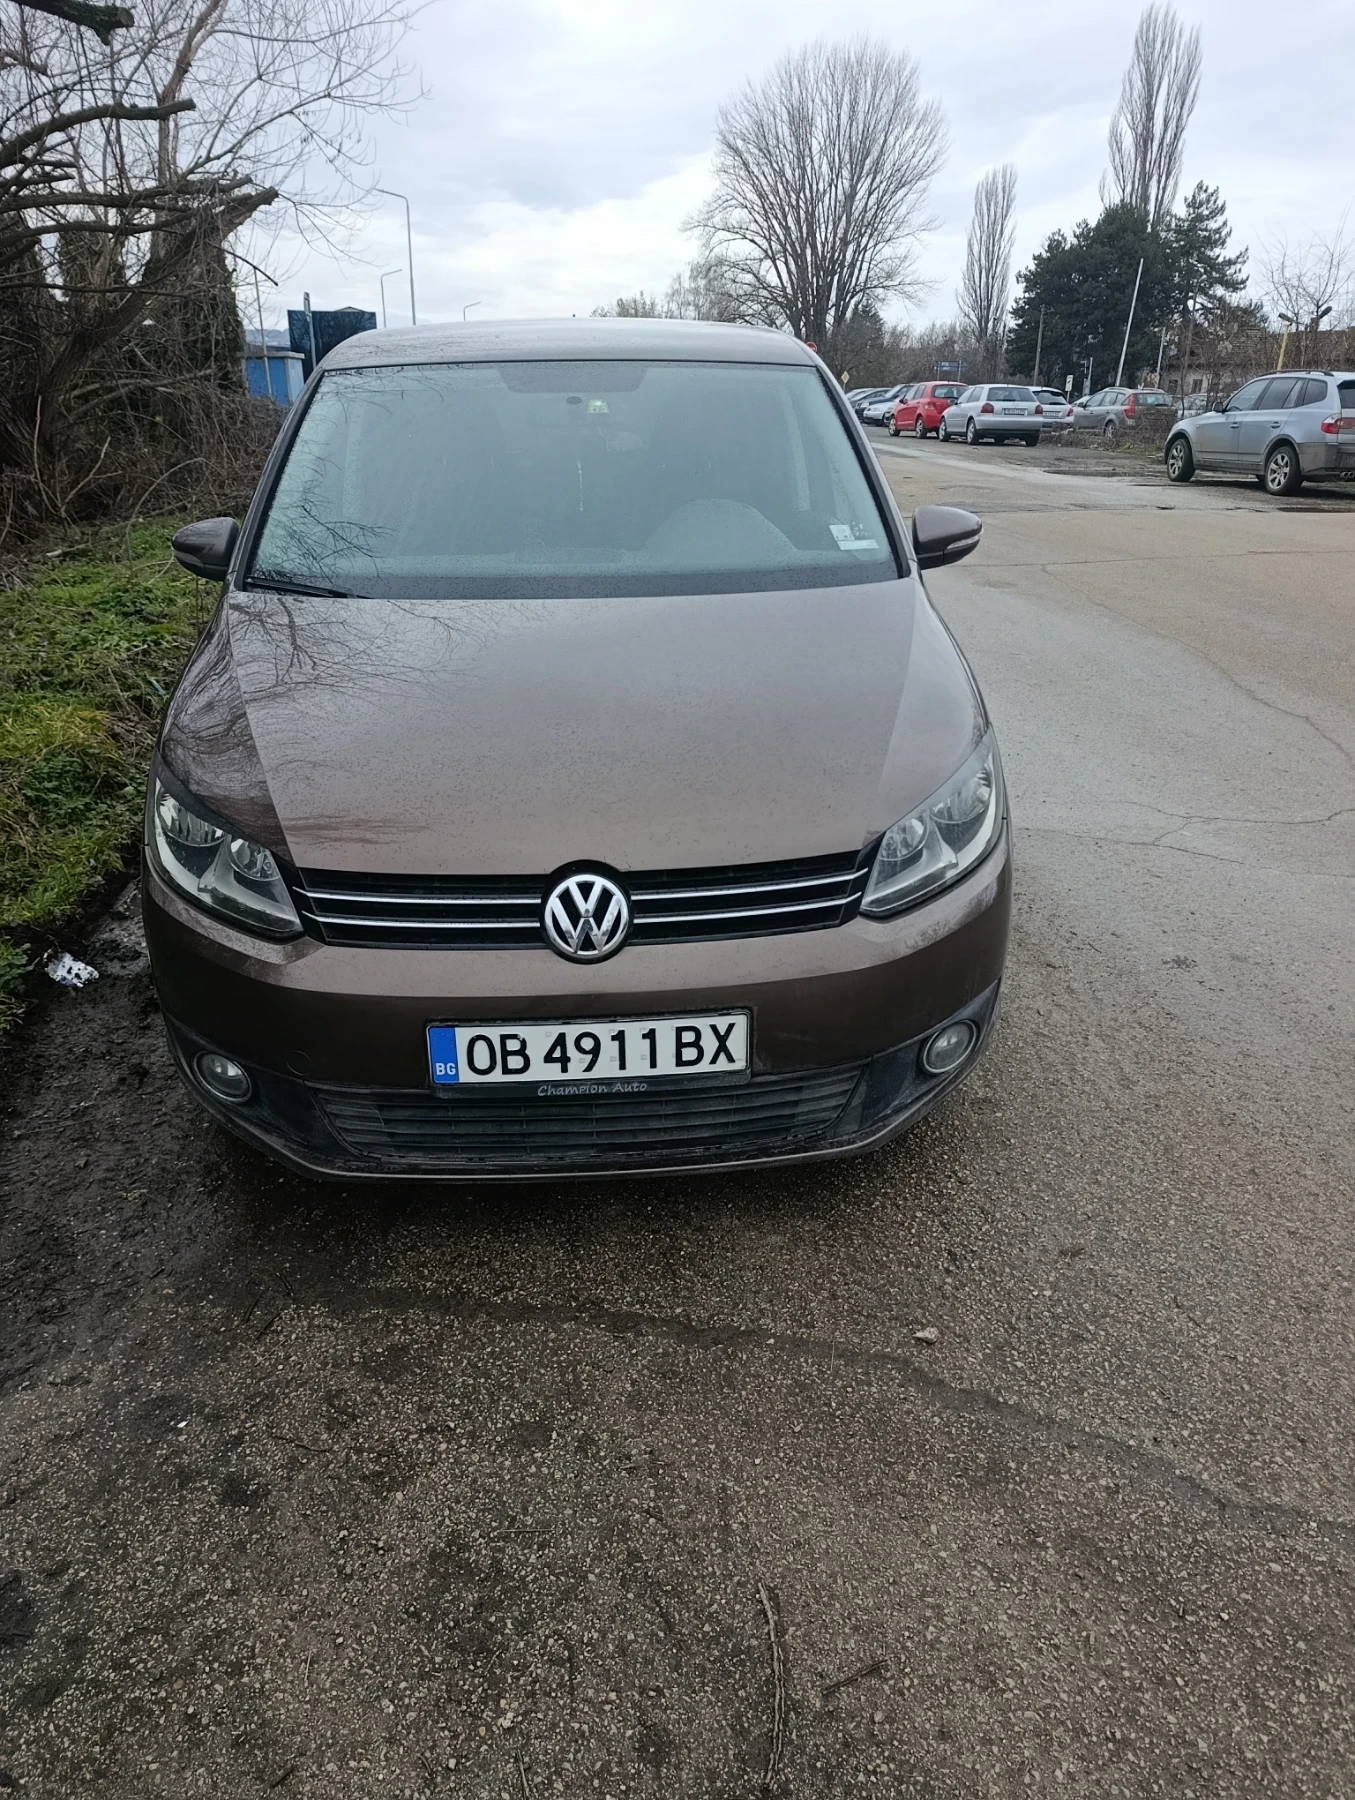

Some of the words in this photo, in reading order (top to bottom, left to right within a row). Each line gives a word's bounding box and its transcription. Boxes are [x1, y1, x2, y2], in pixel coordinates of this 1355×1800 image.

[466, 1033, 531, 1076] OB
[435, 1062, 456, 1076] BG
[537, 1083, 607, 1096] Champion
[613, 1082, 647, 1093] Auto
